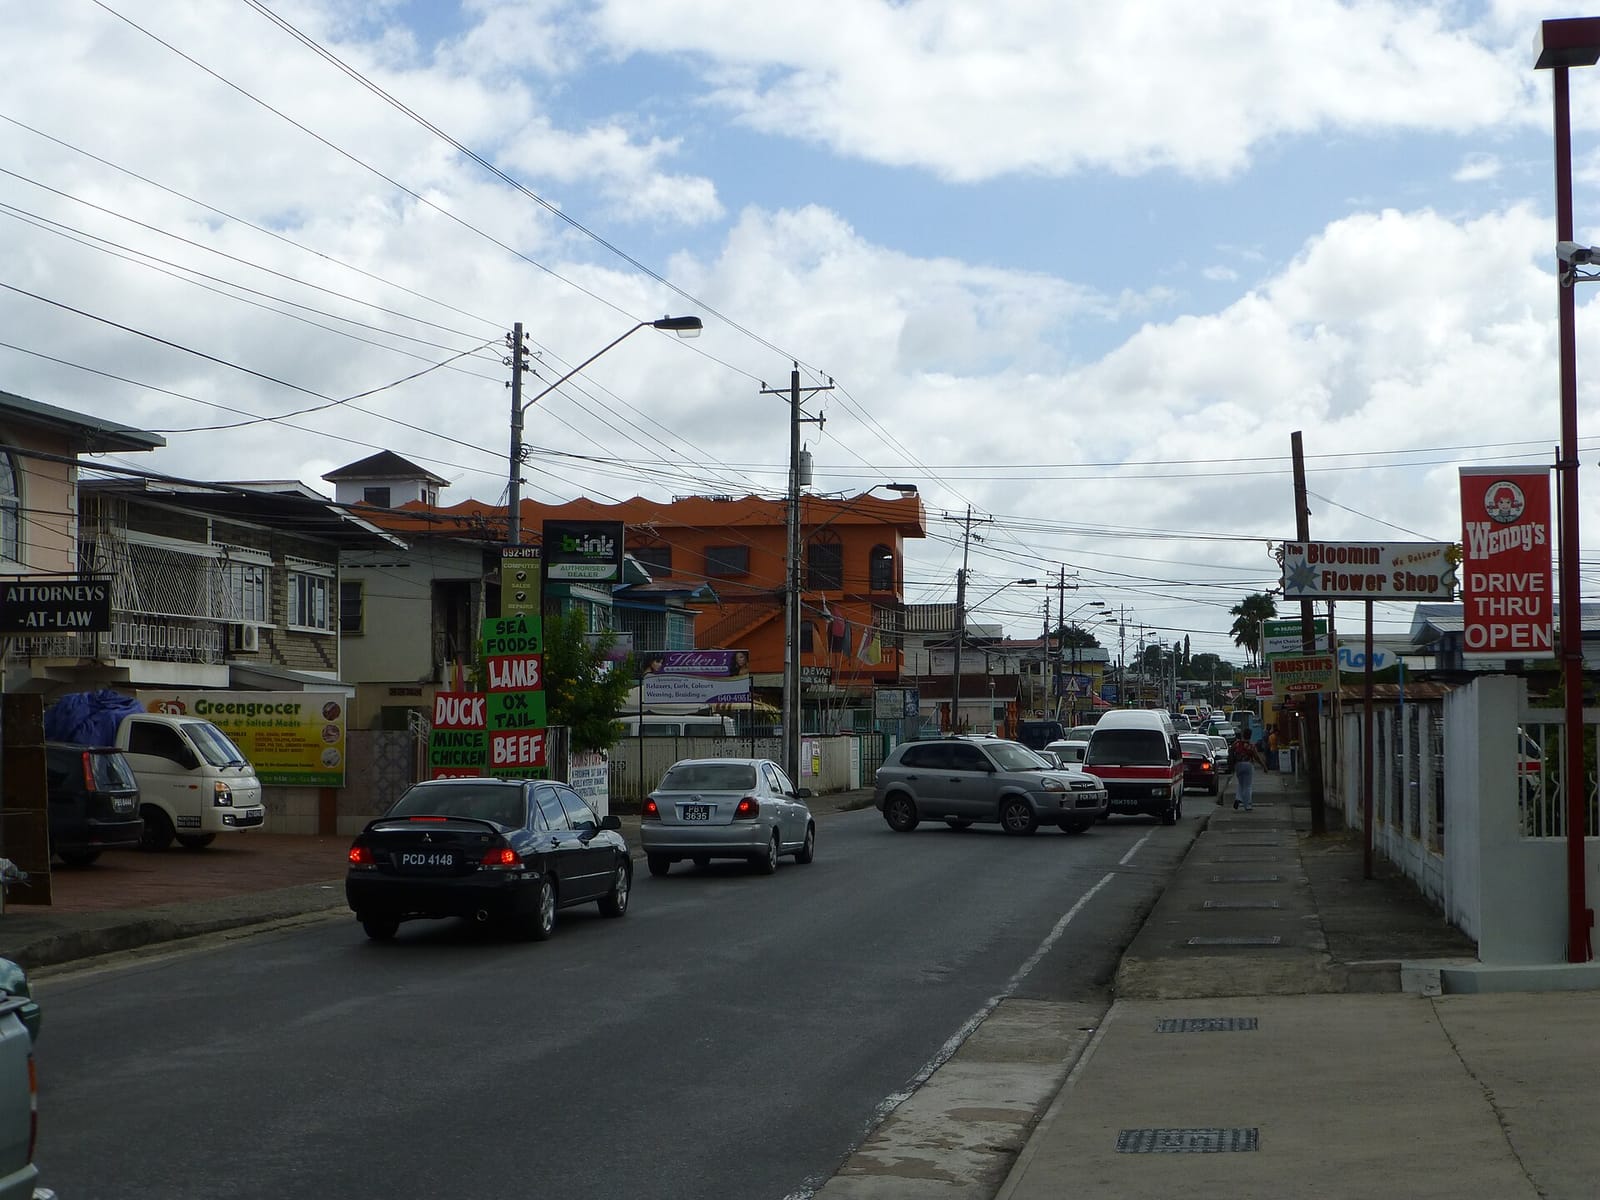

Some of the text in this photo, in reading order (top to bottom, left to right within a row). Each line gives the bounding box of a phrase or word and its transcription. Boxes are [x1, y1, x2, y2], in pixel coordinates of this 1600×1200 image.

[1287, 543, 1385, 564] The Bloomin'
[1392, 558, 1404, 567] We
[1321, 570, 1438, 593] Flower Shop
[1471, 572, 1545, 592] DRIVE
[6, 586, 105, 602] ATTORNEYS
[1473, 597, 1541, 616] THRU
[496, 620, 528, 635] SEA
[1465, 623, 1552, 648] OPEN
[486, 637, 537, 653] FOODS
[488, 659, 539, 689] LAMB
[194, 699, 301, 717] Greengrocer
[503, 694, 528, 710] OX
[435, 696, 485, 727] DUCK
[275, 719, 301, 727] Meats
[495, 712, 535, 728] TAIL
[432, 732, 484, 748] MINCE
[493, 734, 542, 764] BEEF
[431, 750, 486, 766] CHICKEN
[402, 853, 453, 865] PCD 4148
